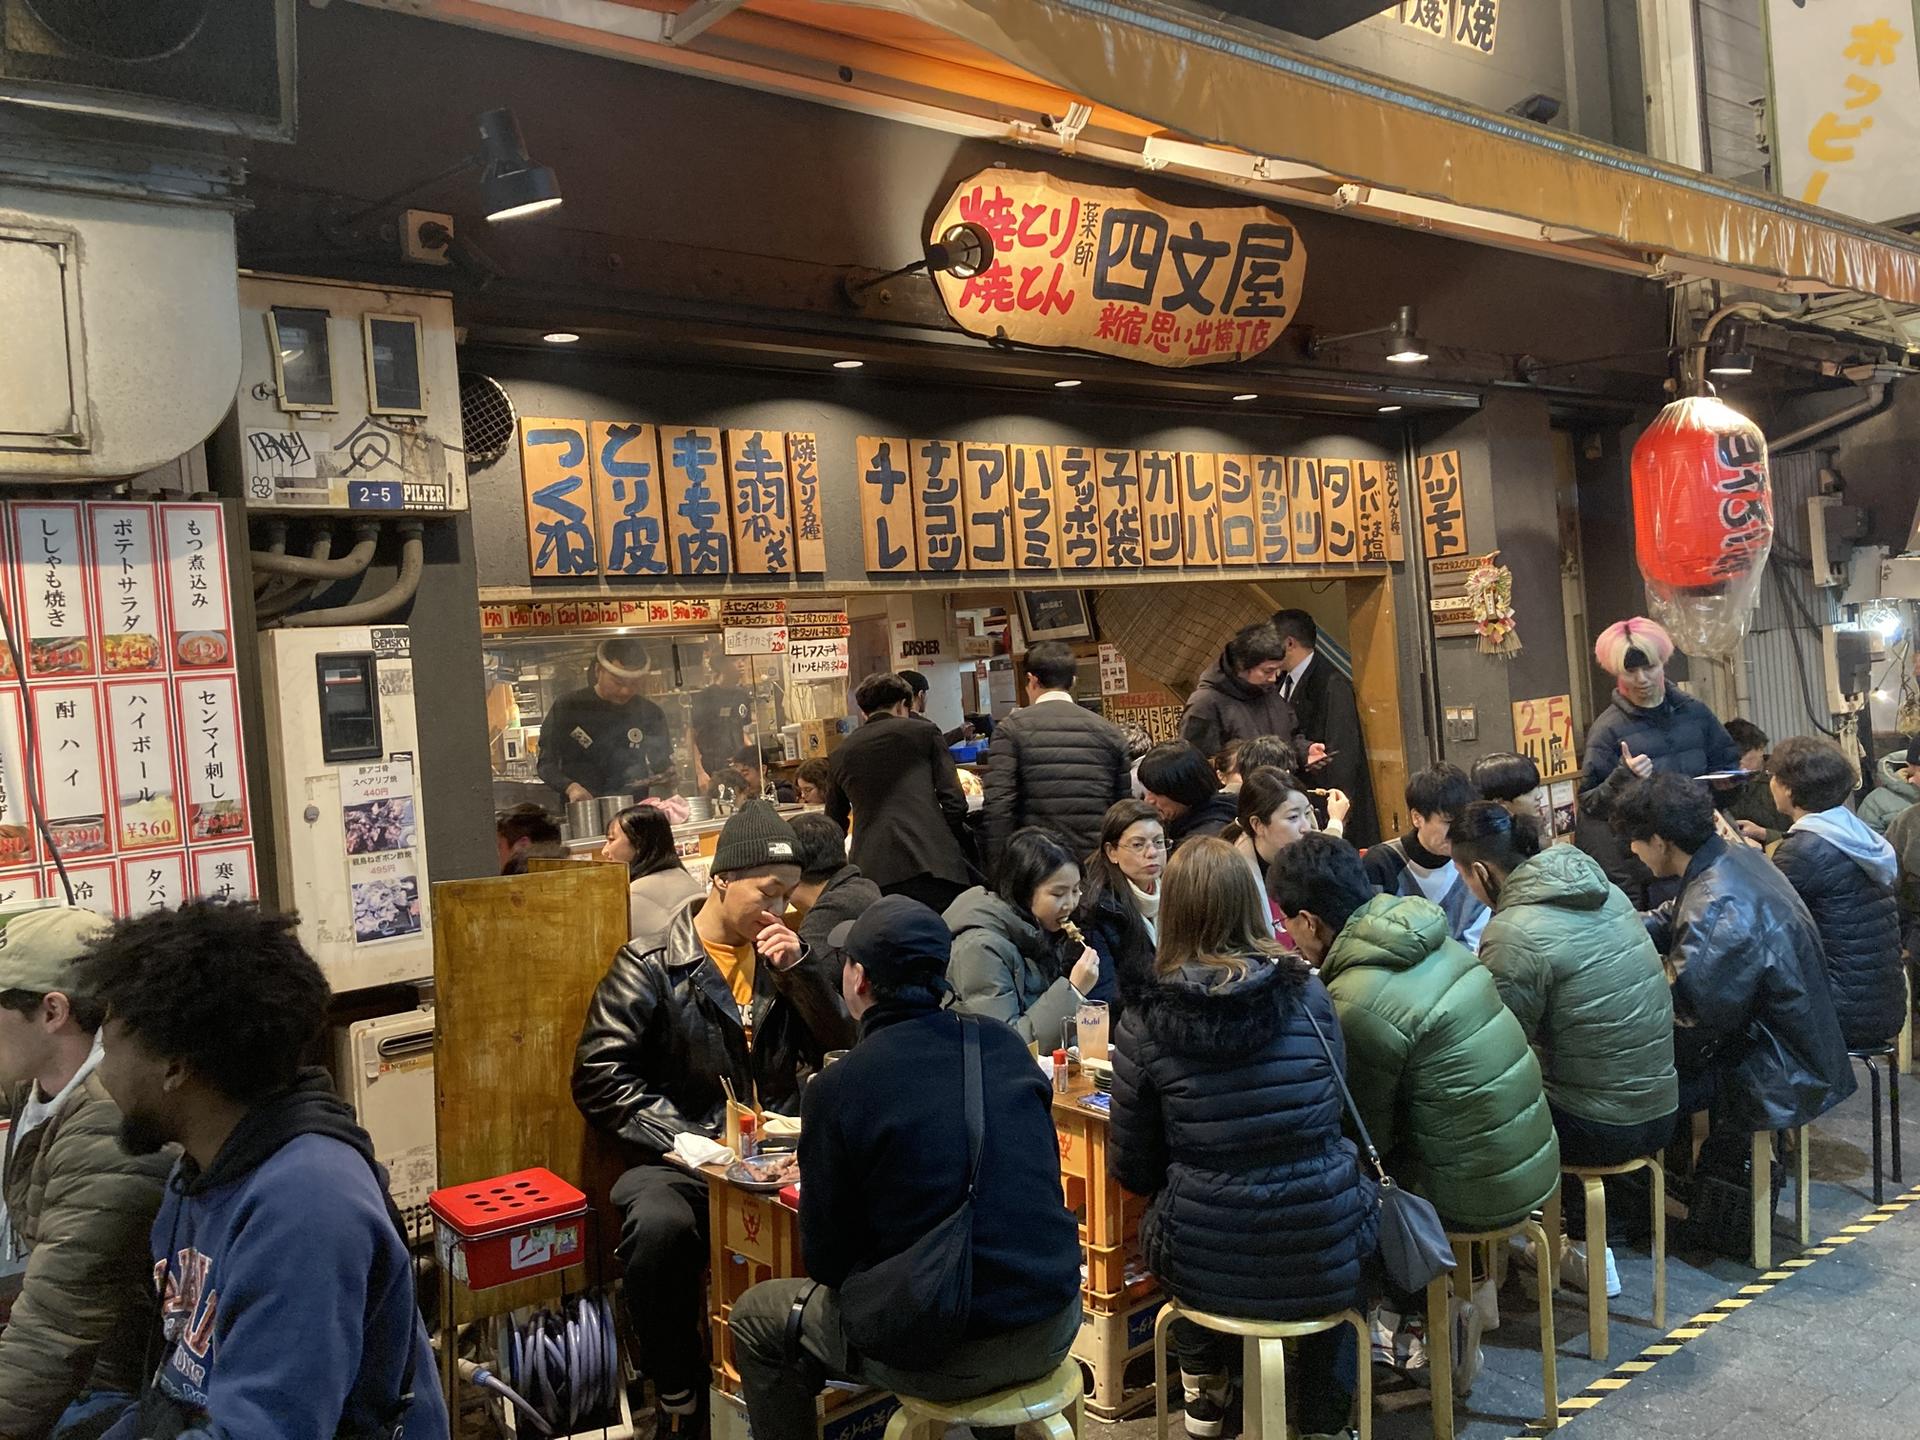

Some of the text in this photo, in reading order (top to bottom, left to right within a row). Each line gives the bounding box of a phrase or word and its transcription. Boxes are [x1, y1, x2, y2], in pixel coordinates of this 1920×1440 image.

[1073, 201, 1101, 277] 薬師
[1092, 207, 1294, 318] 四文屋
[1094, 302, 1272, 357] 新宿思い出横丁店
[359, 487, 391, 502] 2-5
[403, 485, 444, 502] PILFER
[526, 428, 598, 574] つくね
[600, 424, 669, 574] とり皮
[672, 429, 729, 574] もも肉
[735, 431, 792, 574] 手羽ねぎ
[865, 442, 907, 569] チレ
[921, 441, 962, 571] ナンコツ
[966, 448, 1010, 562] アゴ
[1014, 448, 1052, 568] ハラミ
[1101, 452, 1143, 566] 子袋
[1143, 451, 1183, 562] ガツ
[1186, 454, 1218, 561] レバ
[1222, 460, 1255, 557] シロ
[1257, 457, 1288, 564] カシラ
[1291, 459, 1322, 556] ハツ
[1323, 466, 1355, 557] タン
[1421, 454, 1462, 557] ハツモト
[40, 518, 67, 627] ししゃも焼き
[113, 519, 141, 632] ポテトサラダ
[186, 520, 209, 608] もつ煮込み
[55, 700, 81, 787] 酎ハイ
[128, 695, 156, 804] ハイボール
[198, 690, 226, 799] センマイ刺し
[1520, 697, 1563, 736] 2F
[126, 819, 172, 840] ¥360
[363, 788, 390, 797] 440円
